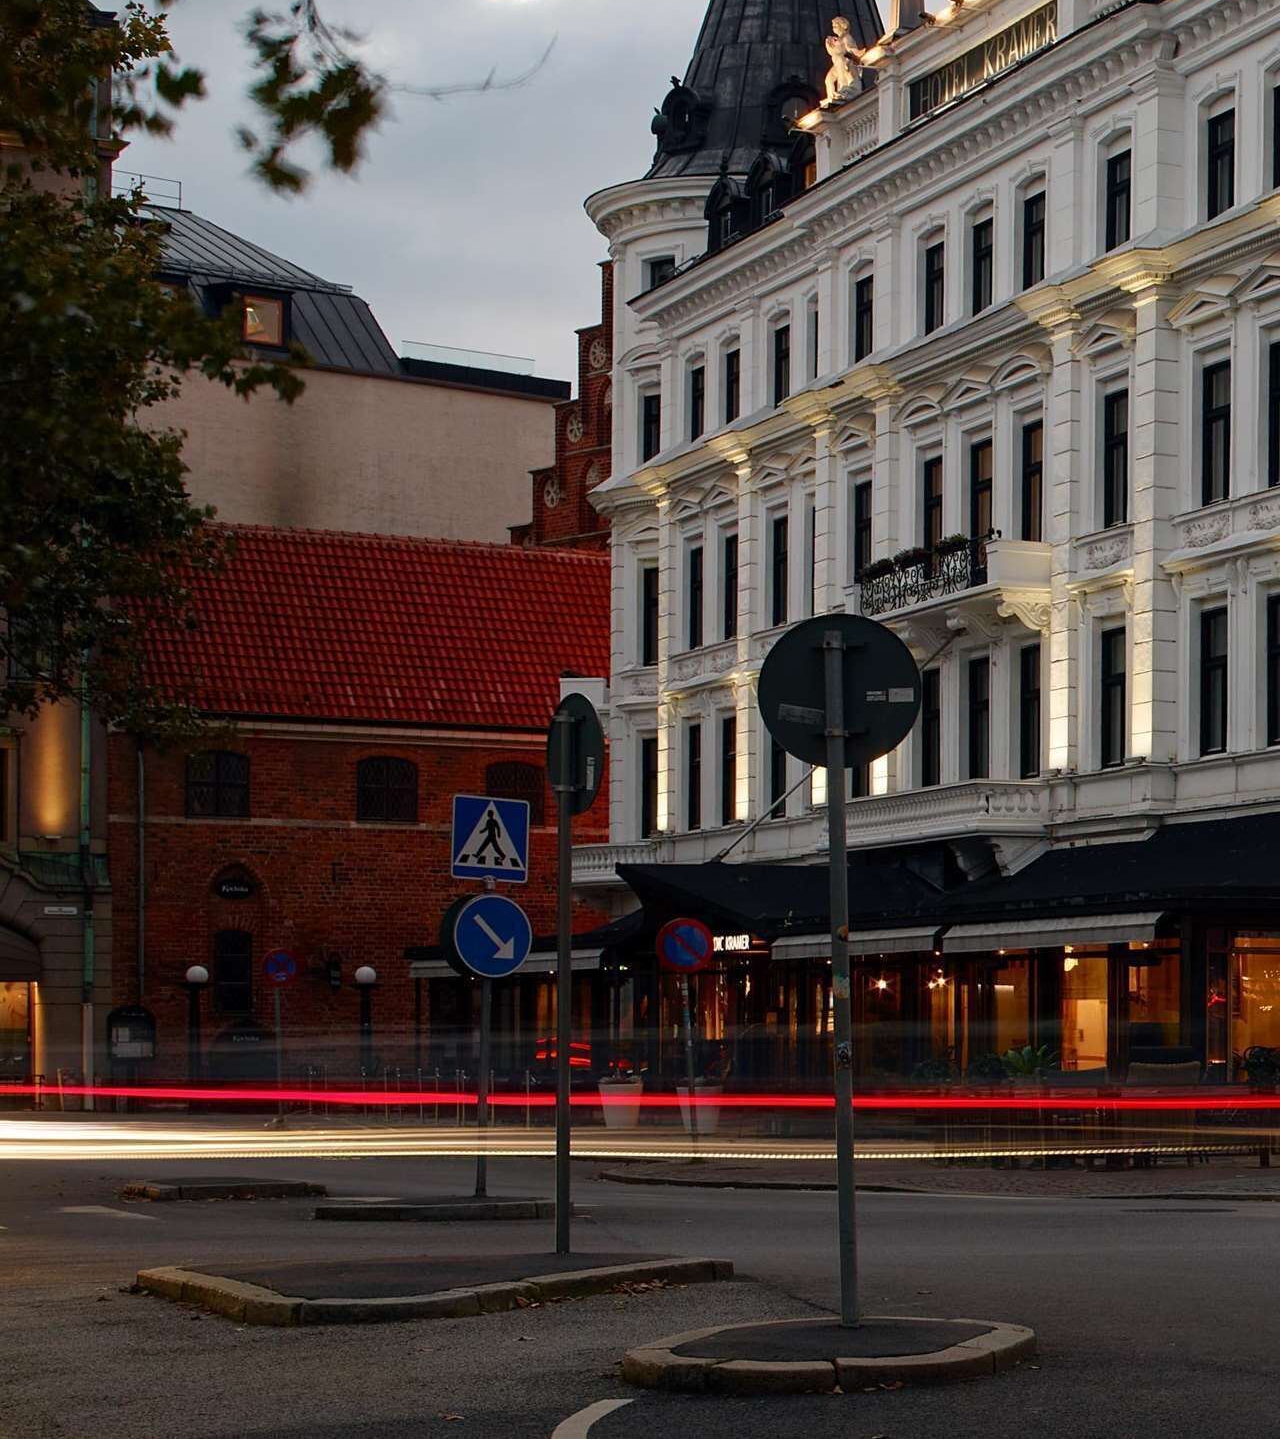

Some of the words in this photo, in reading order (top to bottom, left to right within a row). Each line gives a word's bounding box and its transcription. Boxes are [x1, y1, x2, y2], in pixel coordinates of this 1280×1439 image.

[920, 55, 975, 115] HOTEL
[983, 4, 1057, 79] KRAMER
[725, 934, 750, 951] KRAMER
